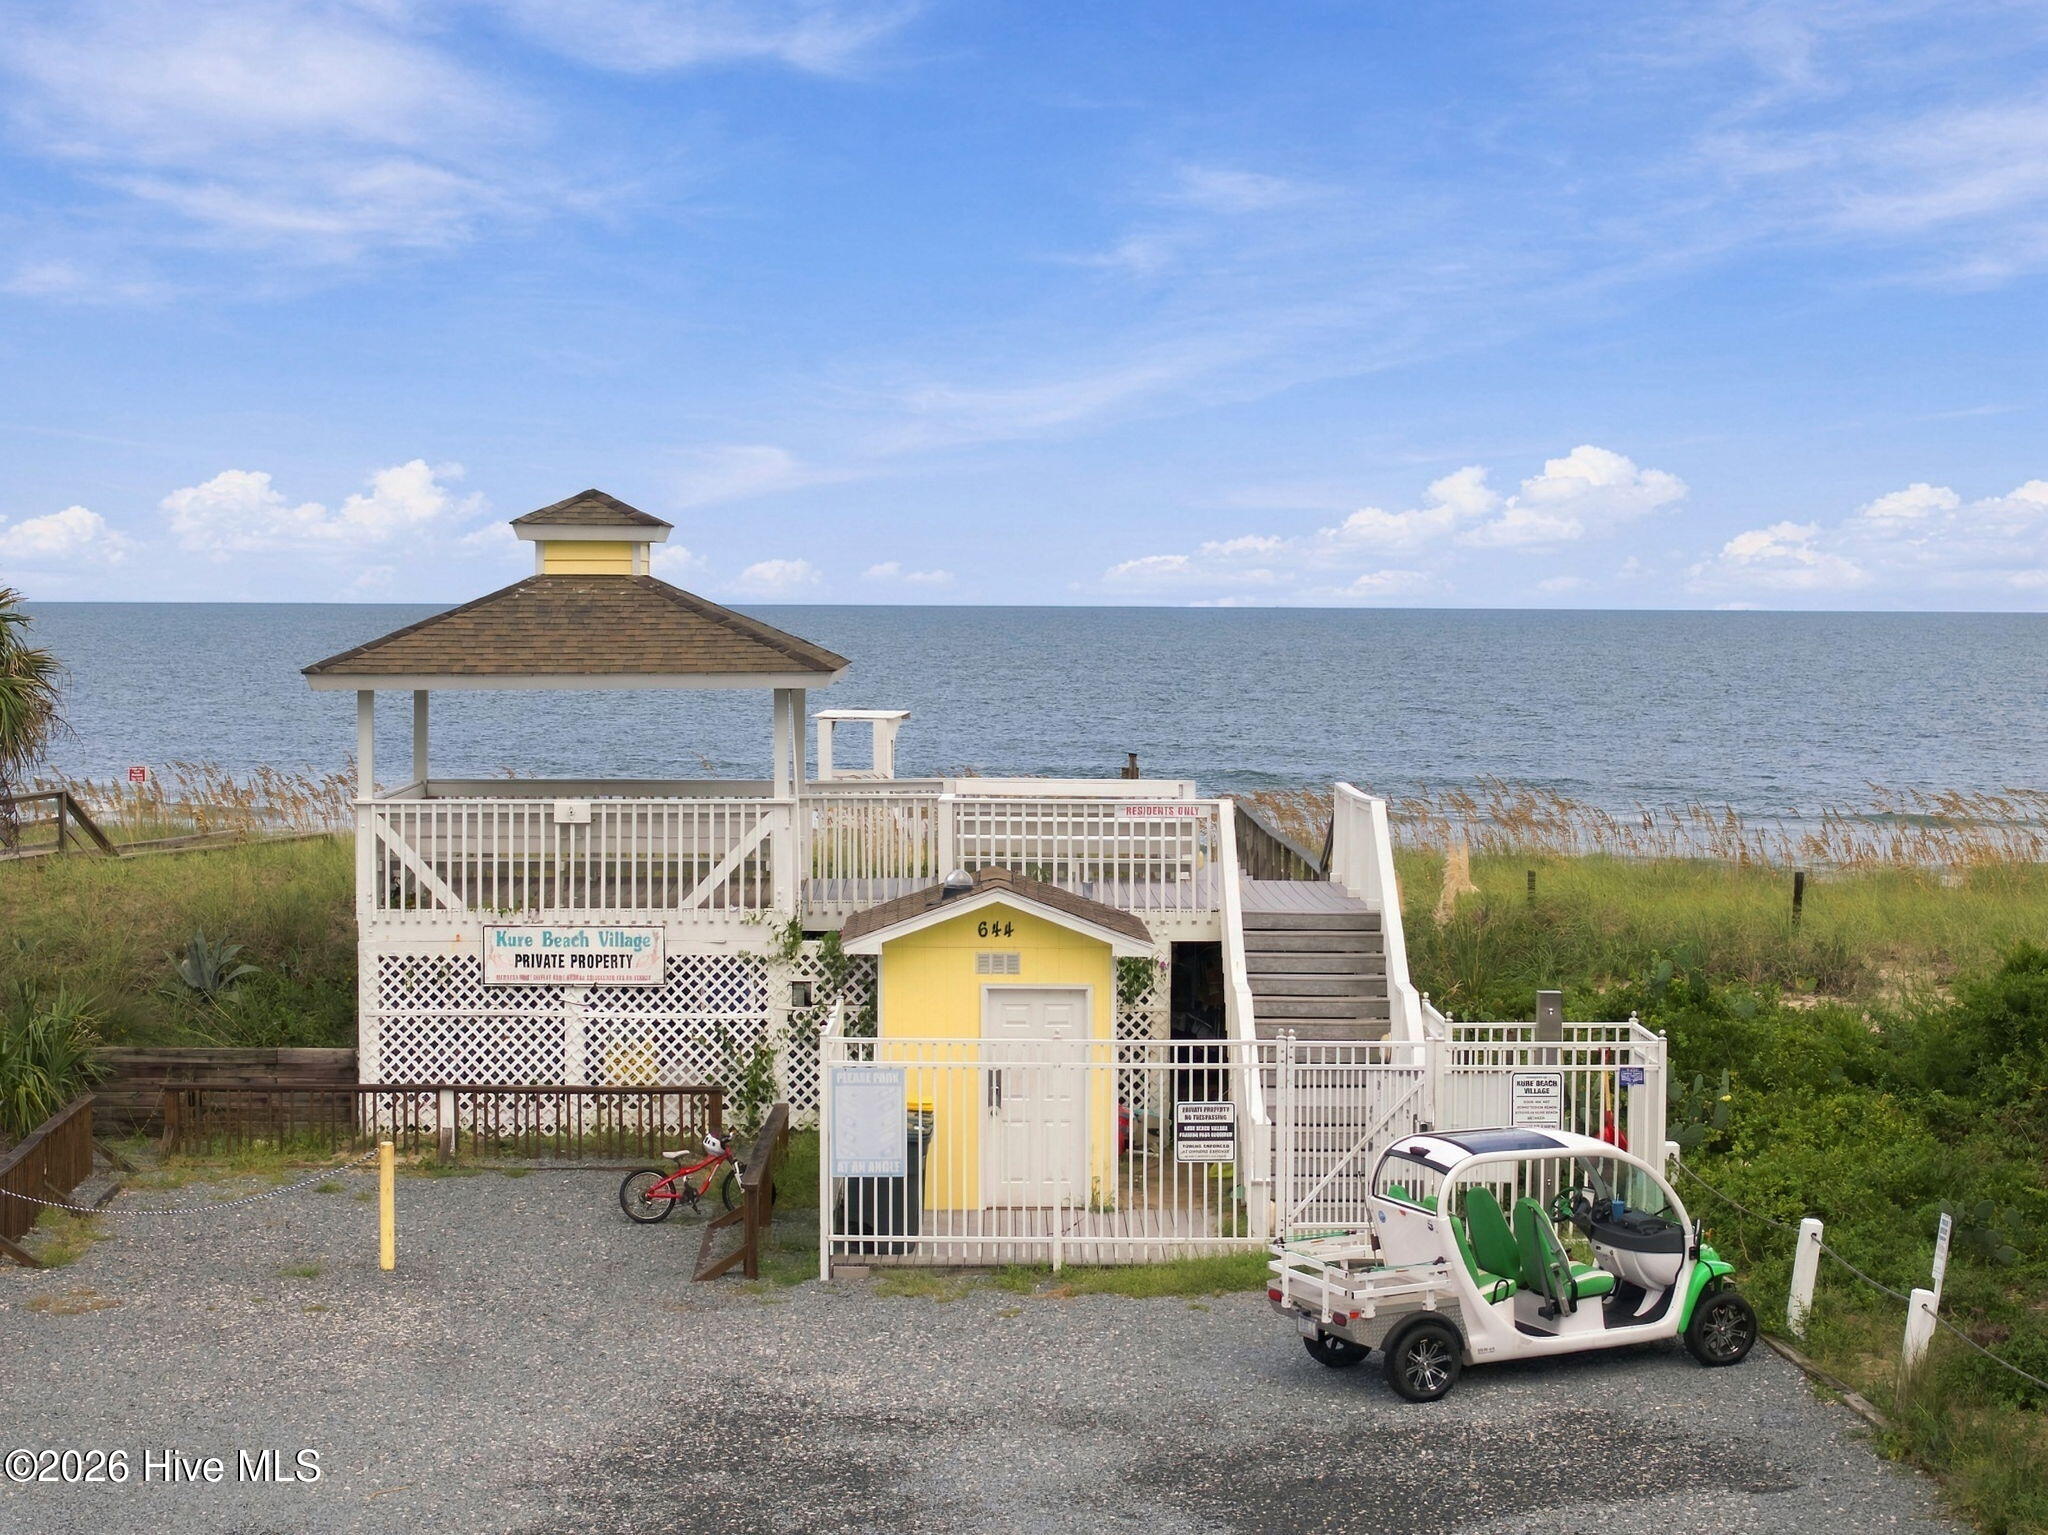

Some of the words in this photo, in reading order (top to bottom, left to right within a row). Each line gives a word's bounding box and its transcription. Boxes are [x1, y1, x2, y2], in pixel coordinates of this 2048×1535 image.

[1126, 806, 1174, 816] RESIDENTS
[1178, 806, 1199, 816] ONLY
[978, 920, 1014, 937] 644
[496, 930, 533, 948] Kure
[542, 930, 589, 948] Beach
[598, 930, 651, 952] Village
[515, 954, 565, 969] PRIVATE
[570, 954, 633, 969] PROPERTY
[837, 1160, 849, 1173] AT
[851, 1160, 866, 1173] AN
[868, 1160, 900, 1173] ANGLE
